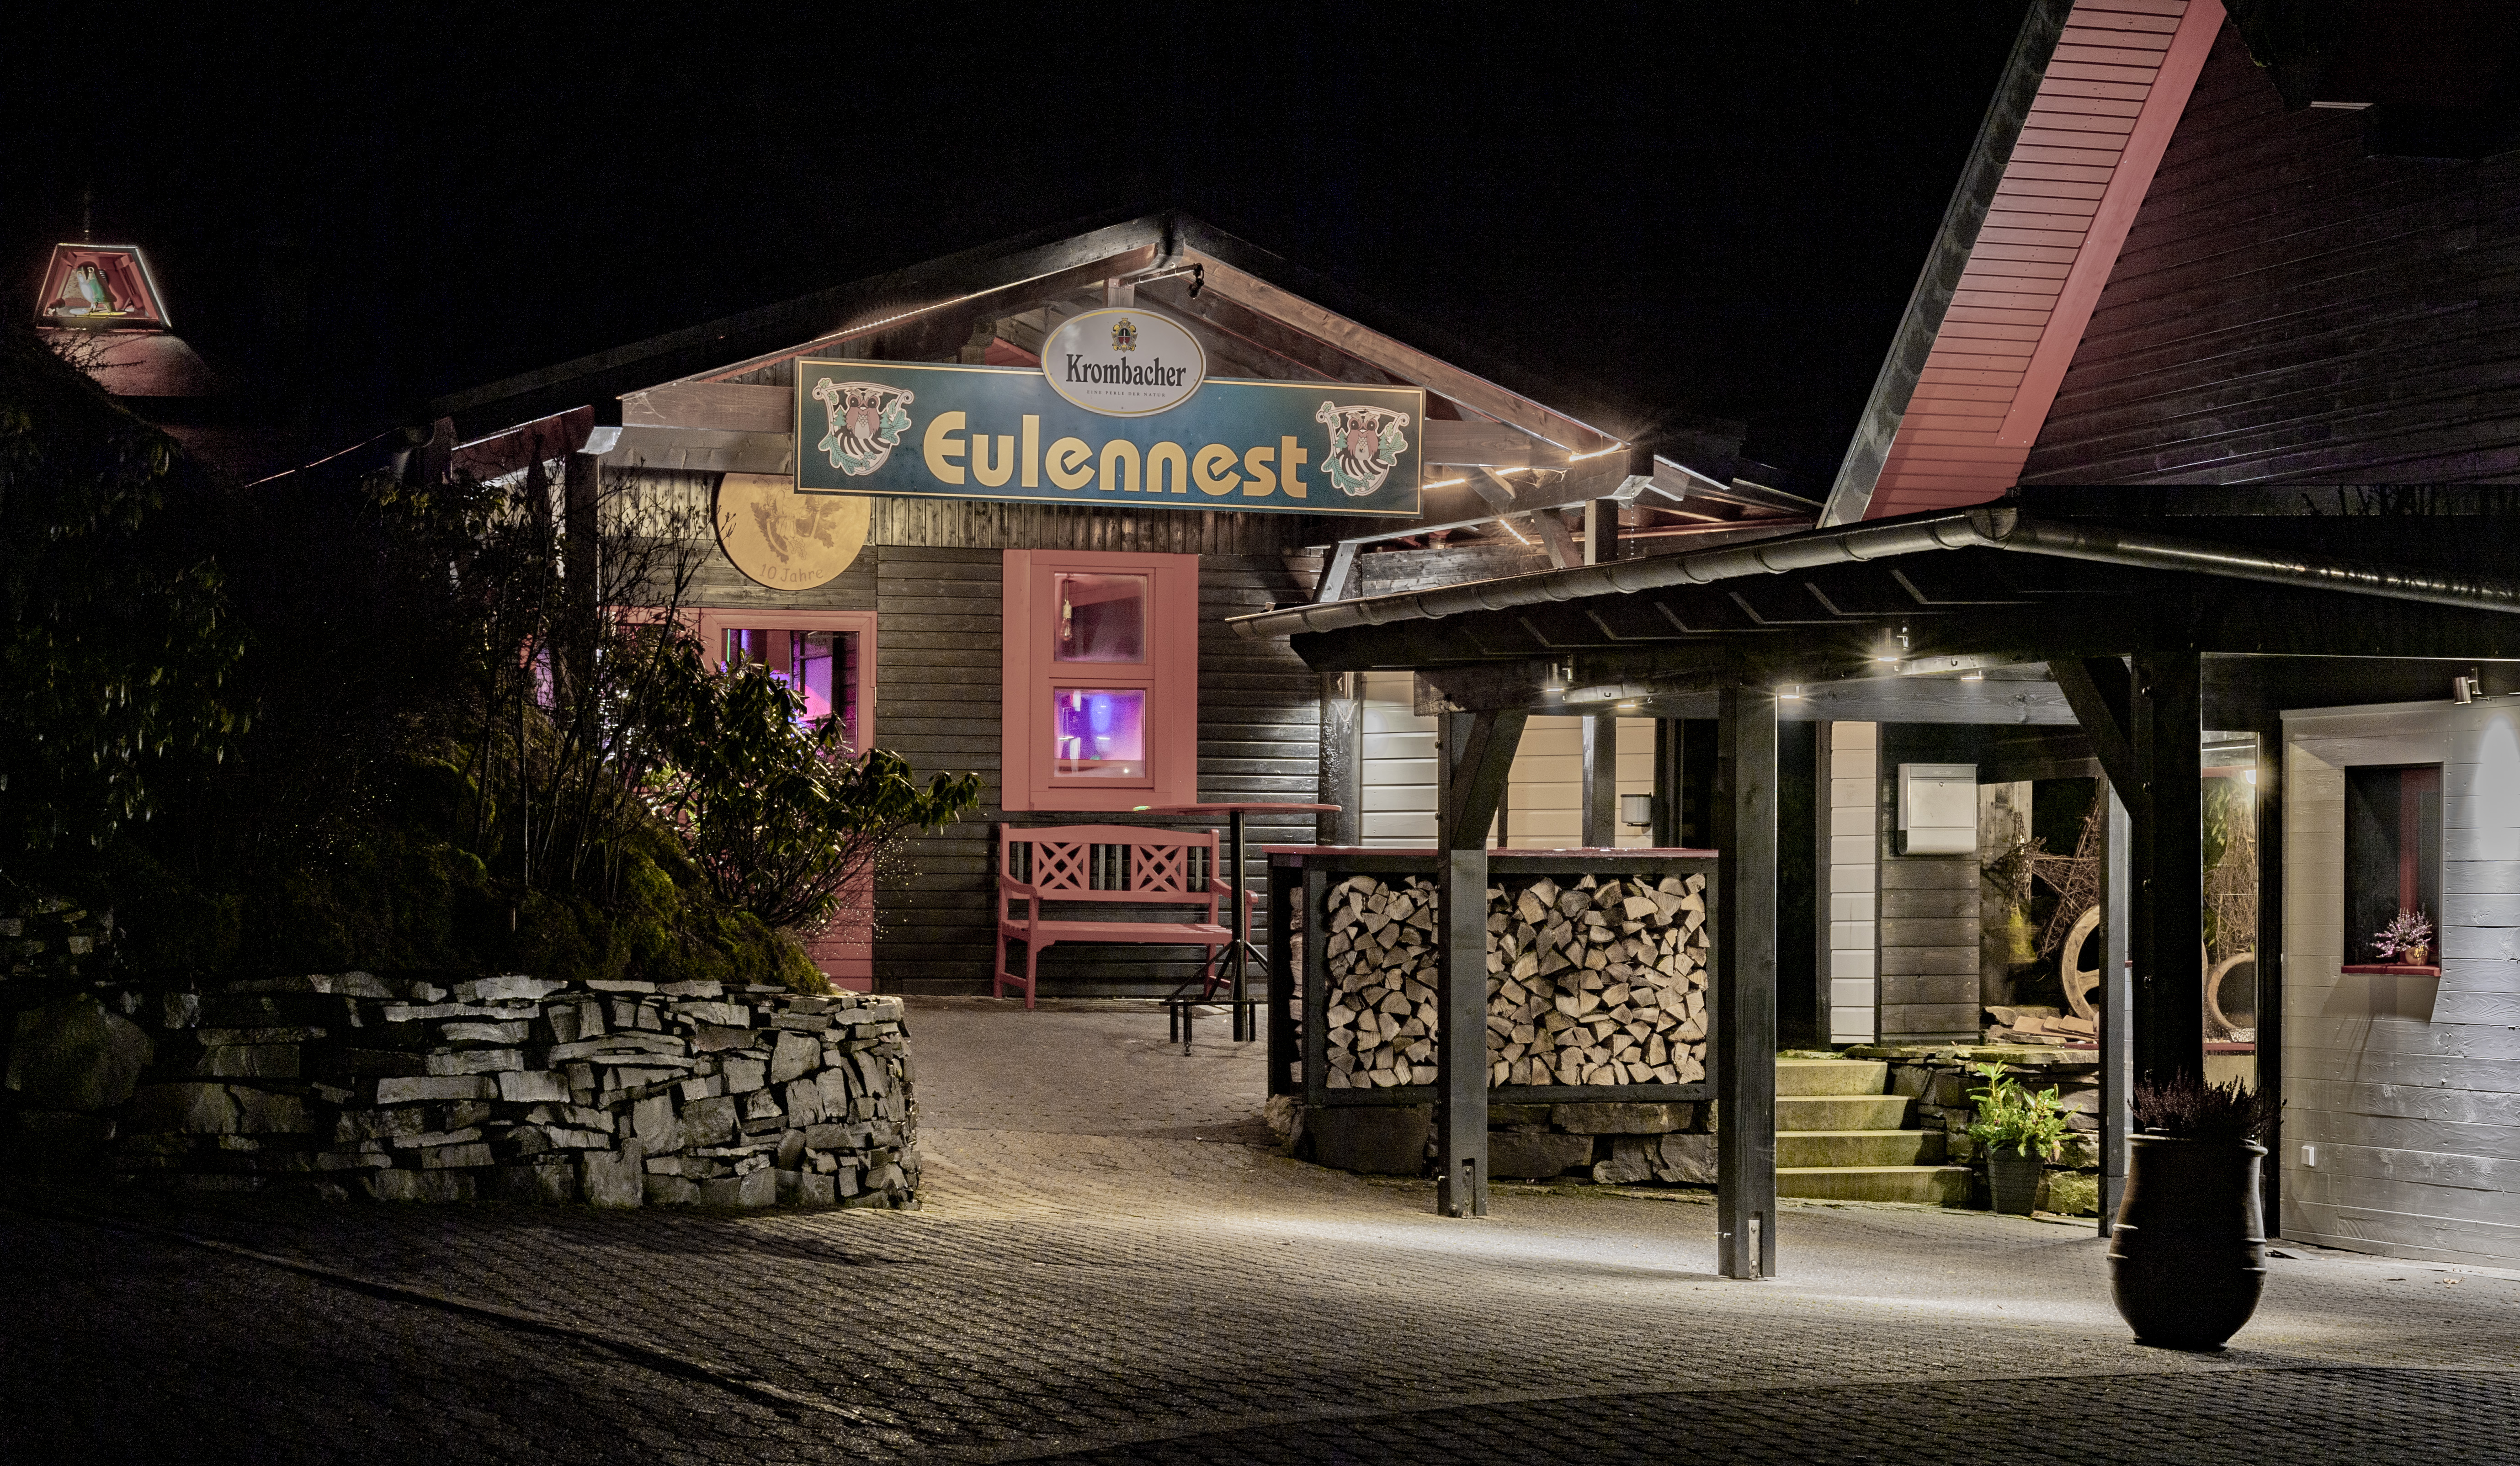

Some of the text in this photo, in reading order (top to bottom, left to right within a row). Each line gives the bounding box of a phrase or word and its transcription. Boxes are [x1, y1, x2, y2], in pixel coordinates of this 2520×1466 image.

[1066, 354, 1186, 386] Krombacher
[924, 411, 1308, 498] Eulennest
[760, 564, 824, 582] 10 Jahre
